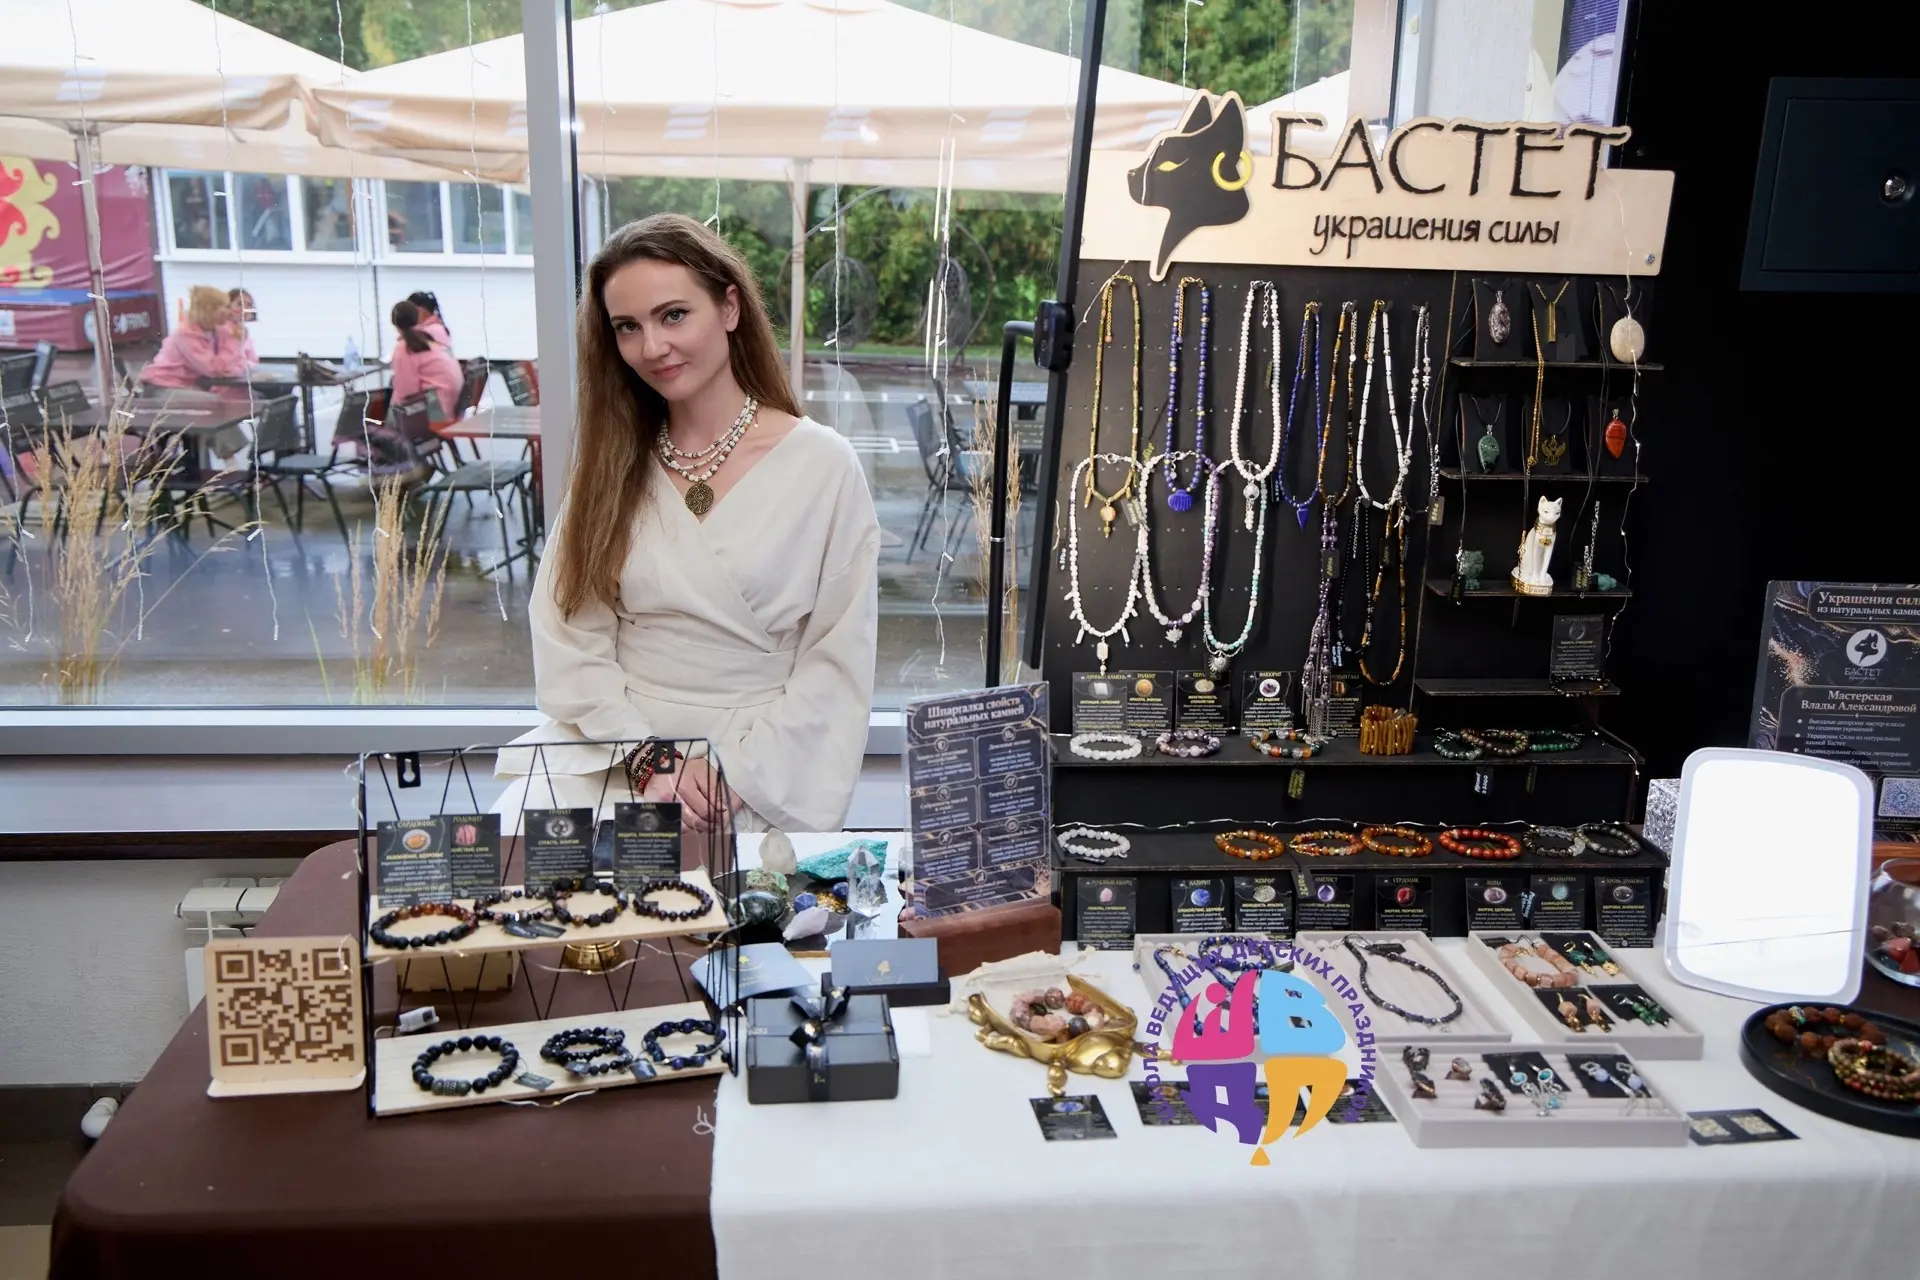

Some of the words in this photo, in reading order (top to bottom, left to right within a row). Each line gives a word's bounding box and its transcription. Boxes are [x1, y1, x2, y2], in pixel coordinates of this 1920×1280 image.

[1271, 116, 1629, 200] БАСТЕТ
[1310, 213, 1480, 259] украшения
[1488, 219, 1560, 245] силы
[1819, 592, 1893, 606] Украшения
[1895, 597, 1920, 606] сил
[1830, 607, 1891, 616] натуральных
[1844, 667, 1884, 676] БАСТЕТ
[1828, 690, 1893, 702] Мастерская
[928, 702, 984, 718] Шпаргалка
[986, 696, 1021, 710] свойств
[1801, 699, 1836, 712] Влады
[1838, 701, 1917, 715] Александровой
[924, 712, 989, 730] натуральных
[991, 704, 1025, 720] камней
